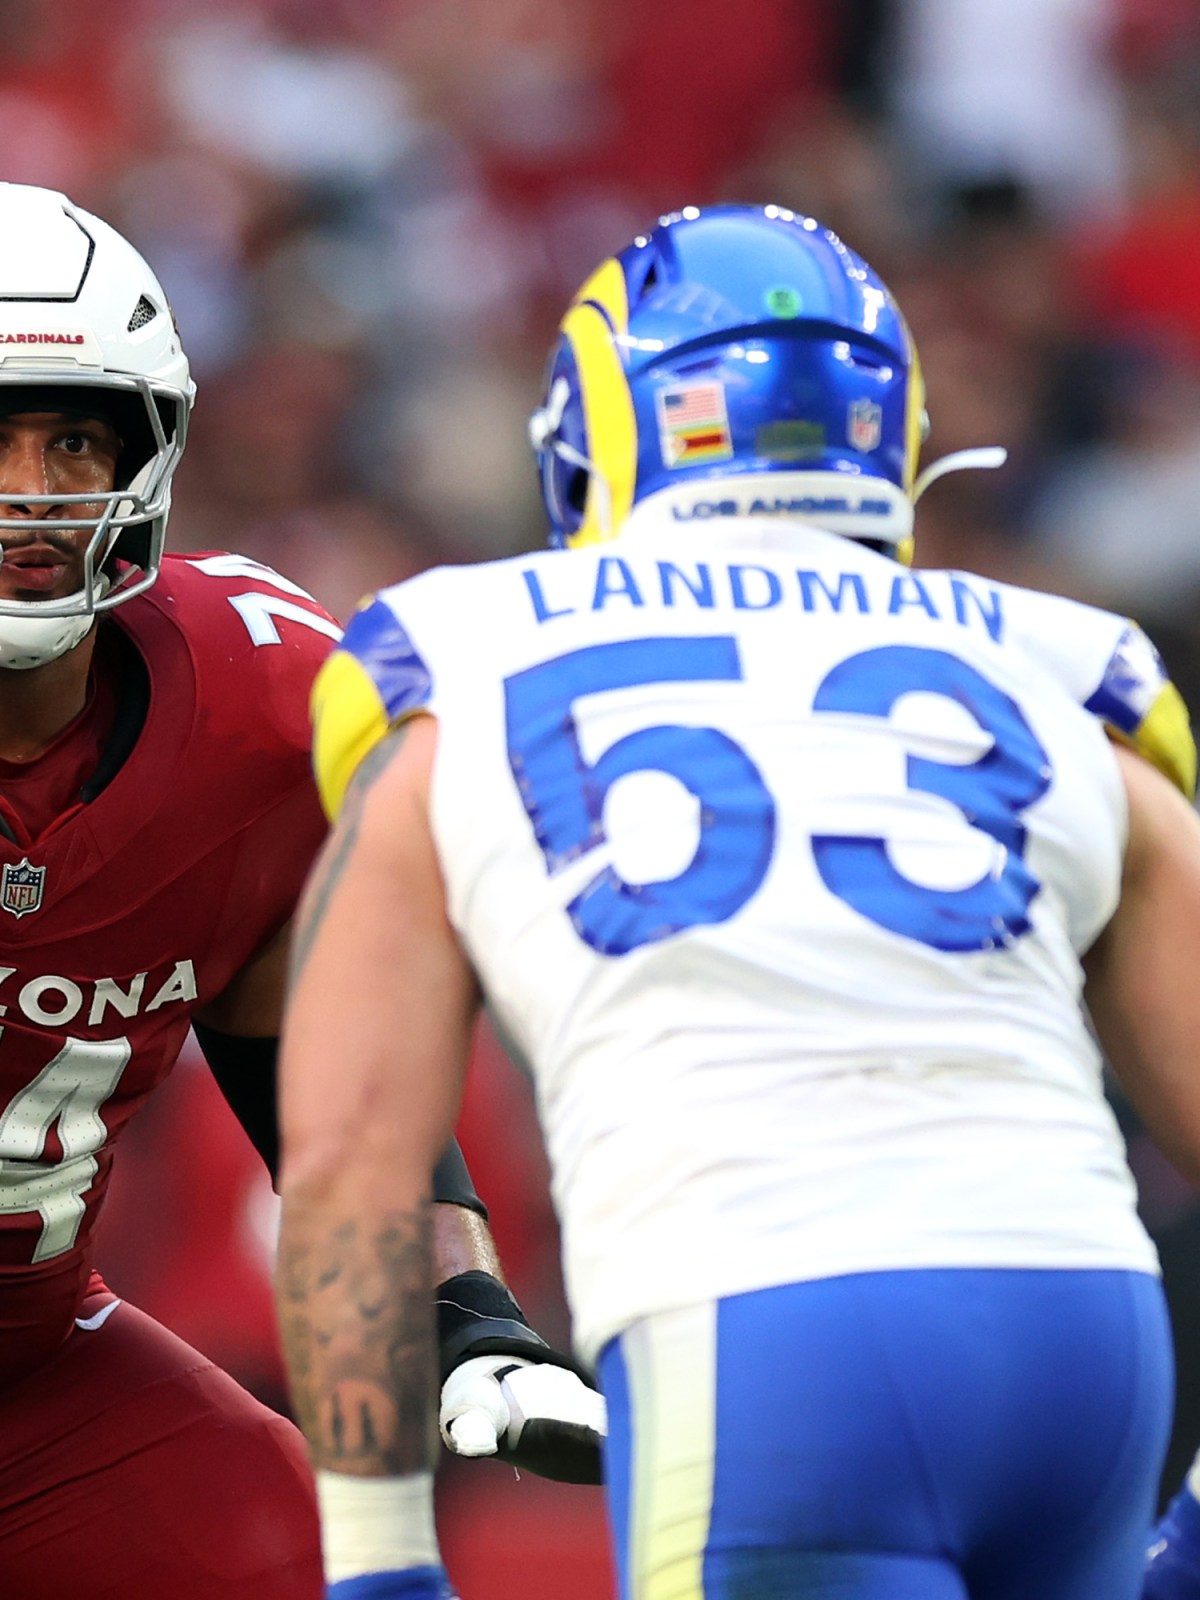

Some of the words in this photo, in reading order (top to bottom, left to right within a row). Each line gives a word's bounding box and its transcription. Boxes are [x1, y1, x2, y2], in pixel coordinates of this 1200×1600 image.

[672, 500, 738, 522] LOS
[522, 557, 1004, 645] LANDMAN
[503, 633, 1052, 957] 53
[7, 885, 35, 909] NFL
